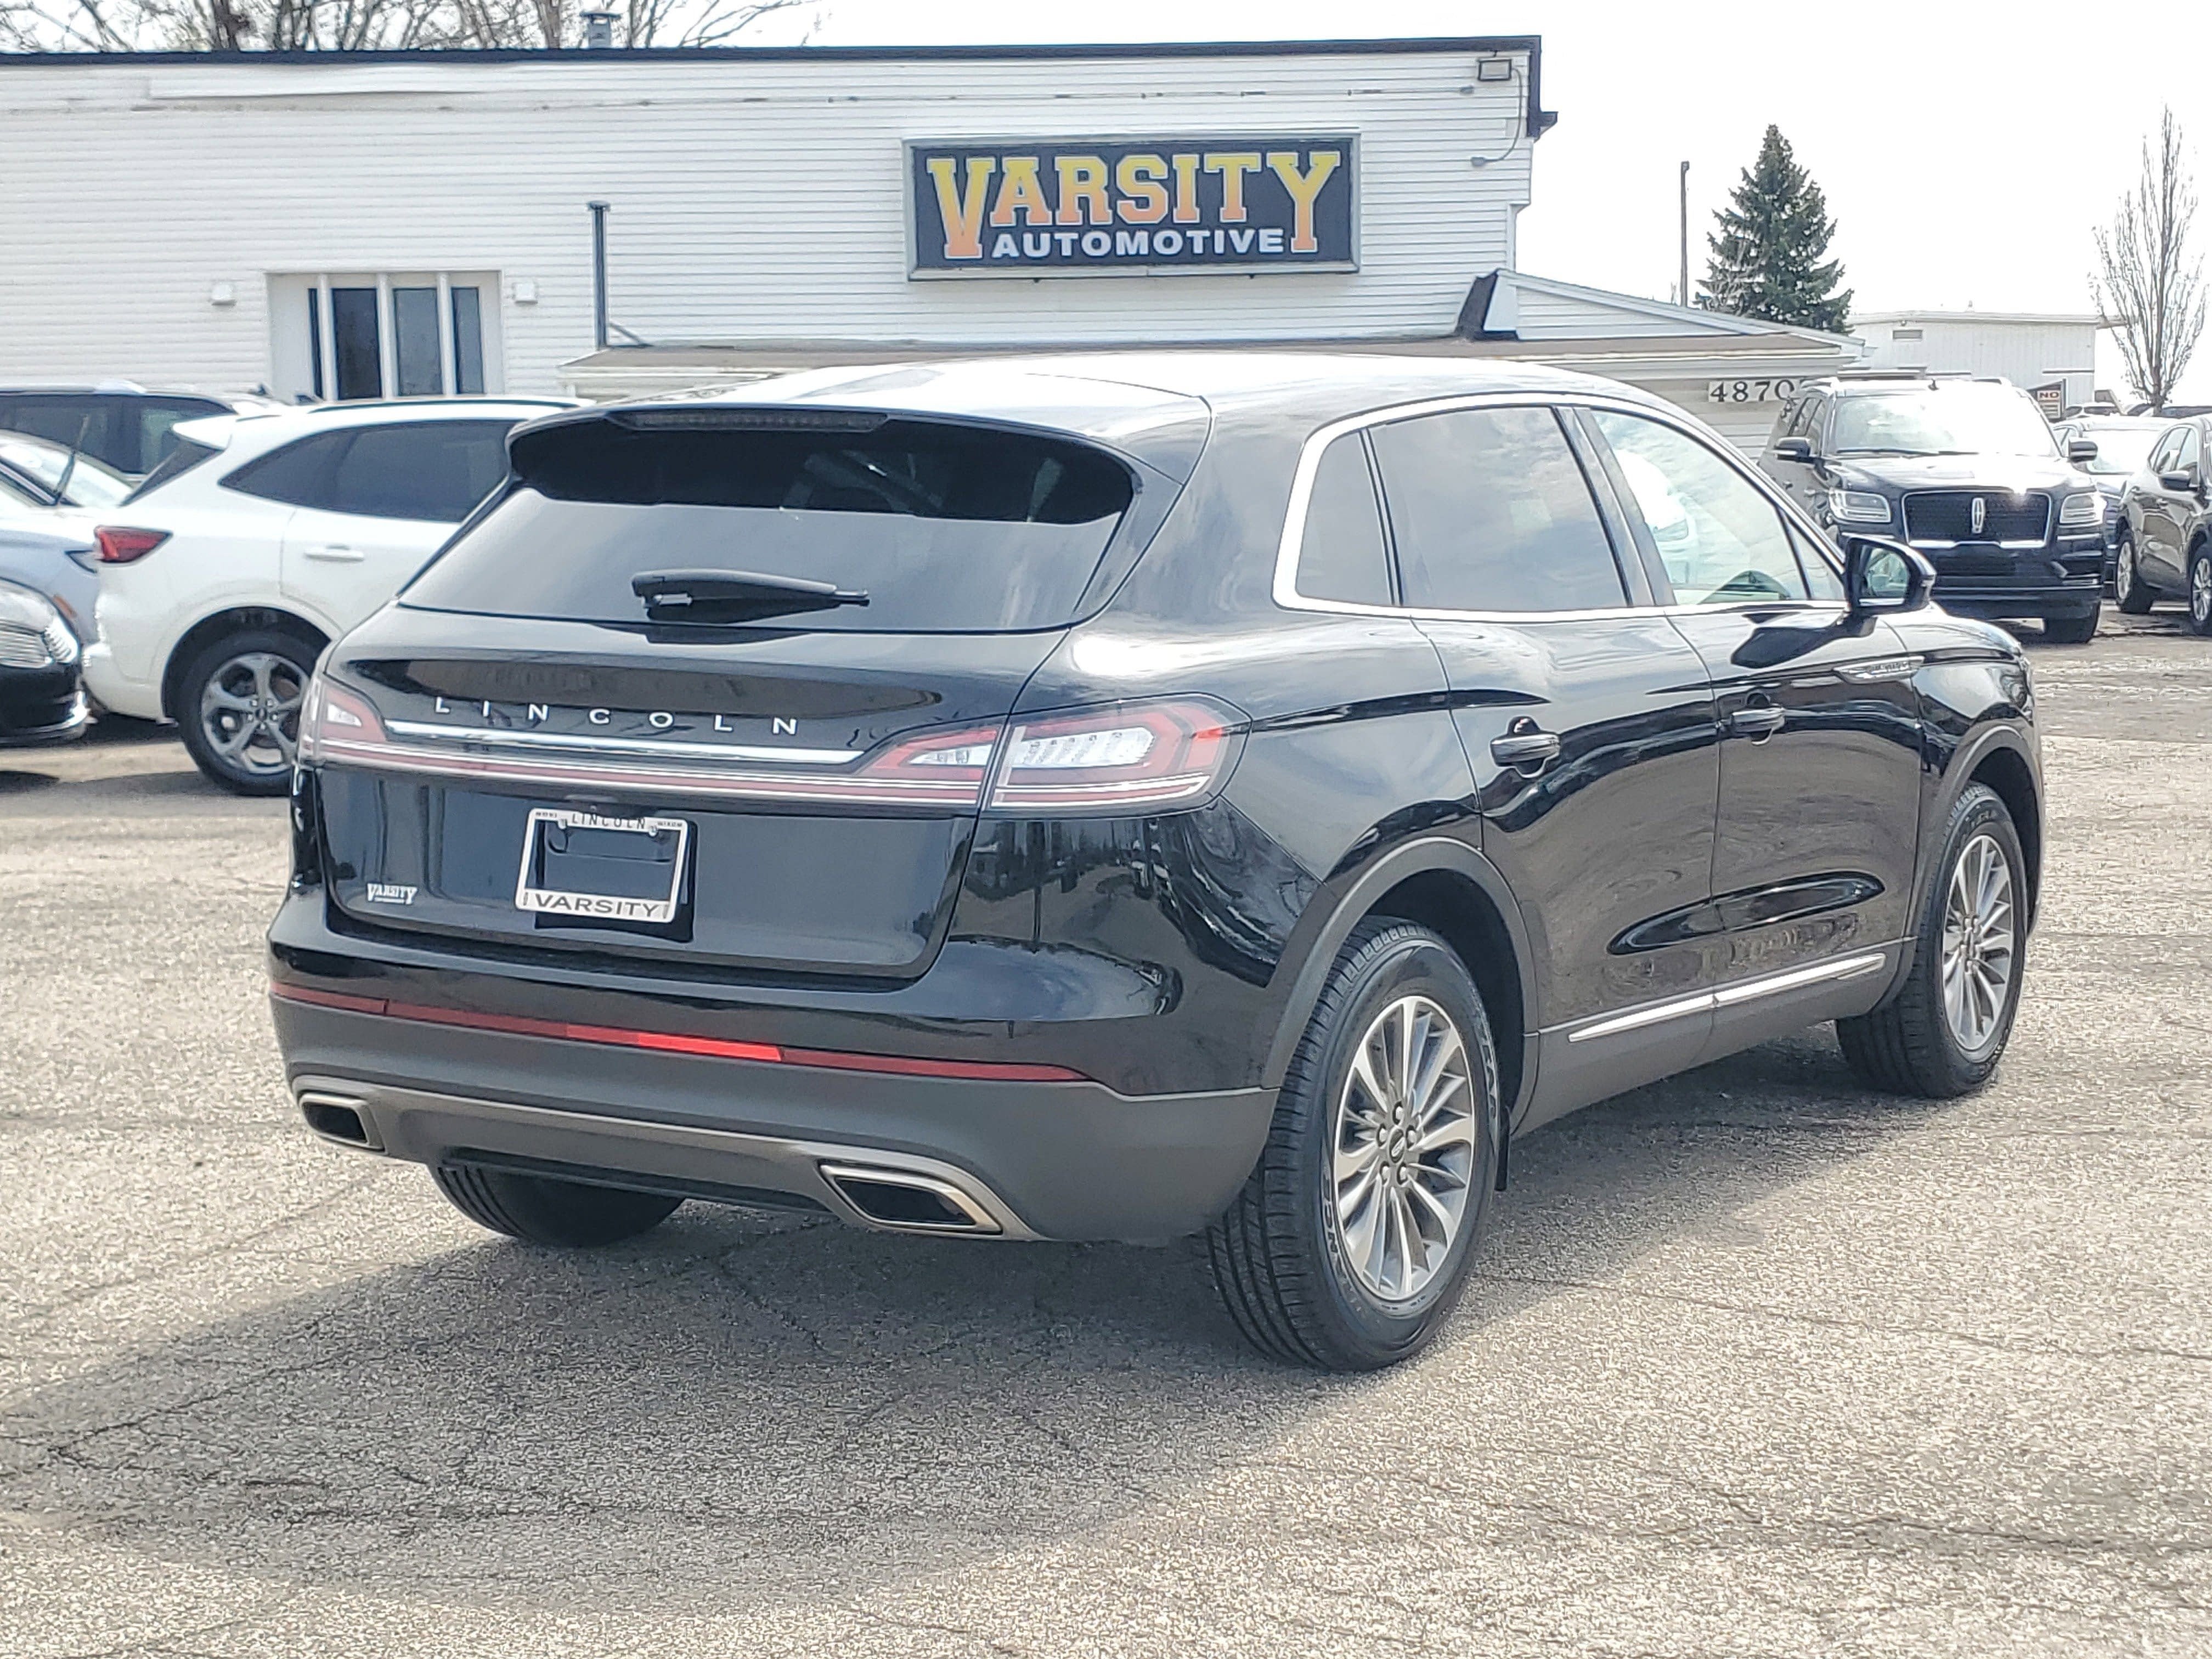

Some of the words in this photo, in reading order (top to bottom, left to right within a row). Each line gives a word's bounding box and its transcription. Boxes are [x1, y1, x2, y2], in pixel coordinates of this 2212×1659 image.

[926, 151, 1341, 259] VARSITY
[991, 229, 1284, 258] AUTOMOTIVE
[1709, 379, 1795, 402] 4870
[436, 696, 797, 735] LINCOLN
[572, 813, 645, 830] LINCOLN
[535, 894, 658, 917] VARSITY
